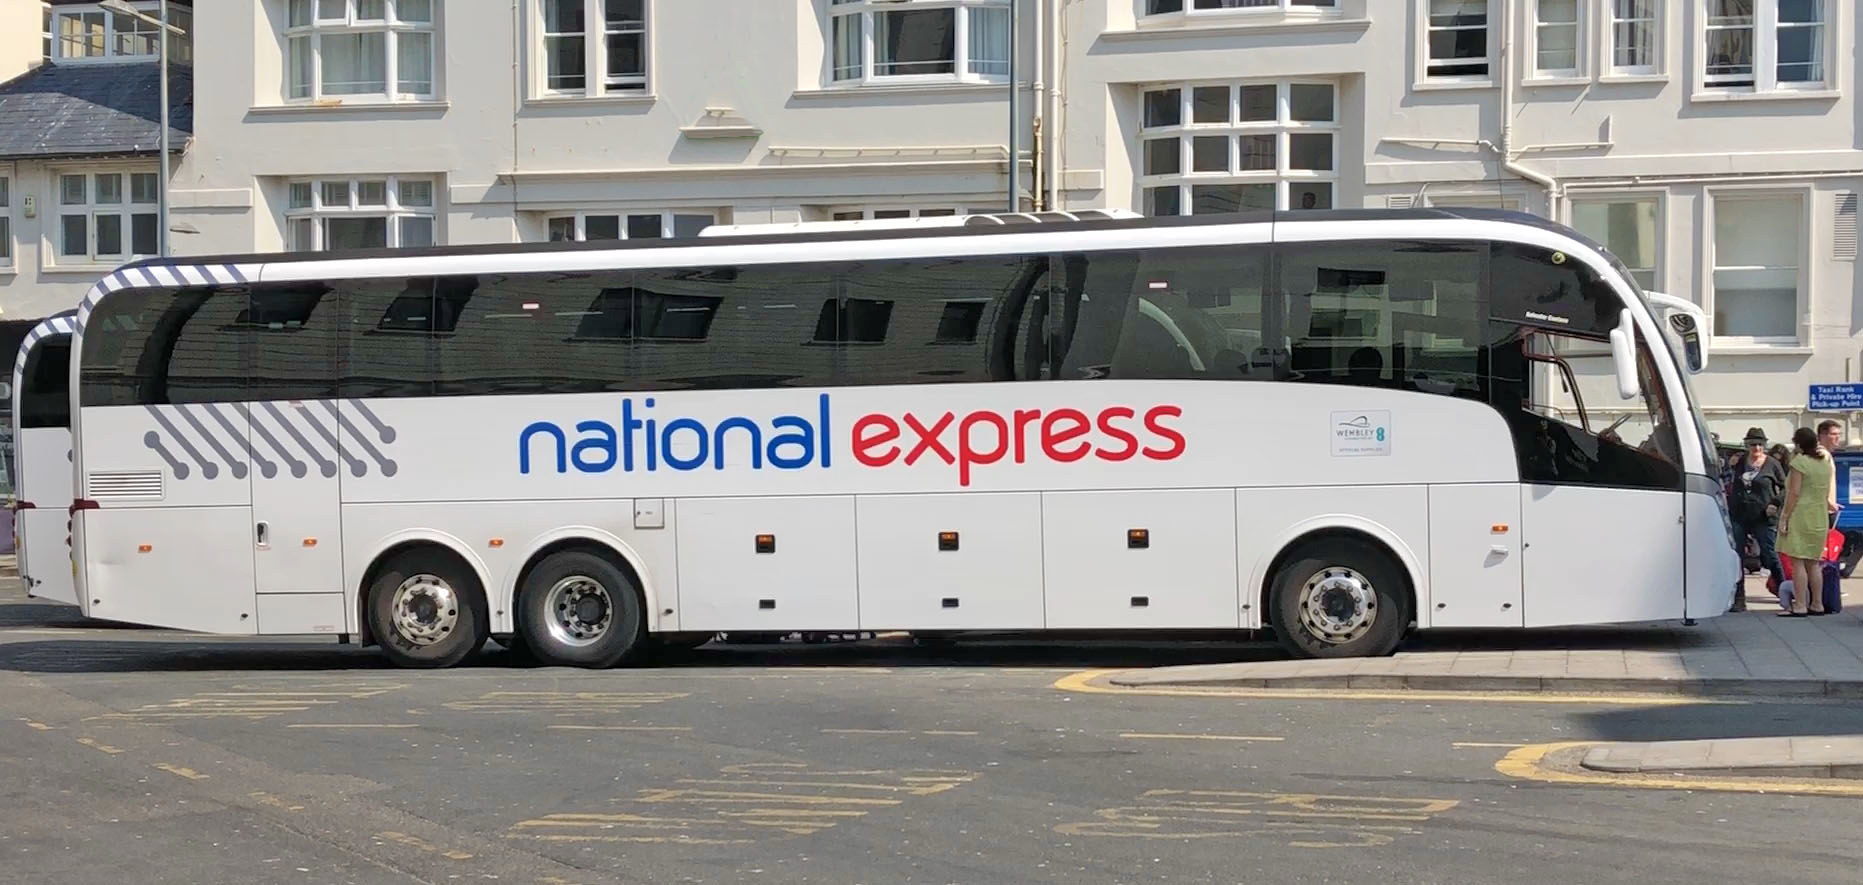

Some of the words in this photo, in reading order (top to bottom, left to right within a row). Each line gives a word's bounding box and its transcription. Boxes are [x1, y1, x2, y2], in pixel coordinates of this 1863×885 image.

[520, 393, 831, 474] national
[851, 405, 1186, 487] express
[1336, 429, 1375, 437] WEMBLEY
